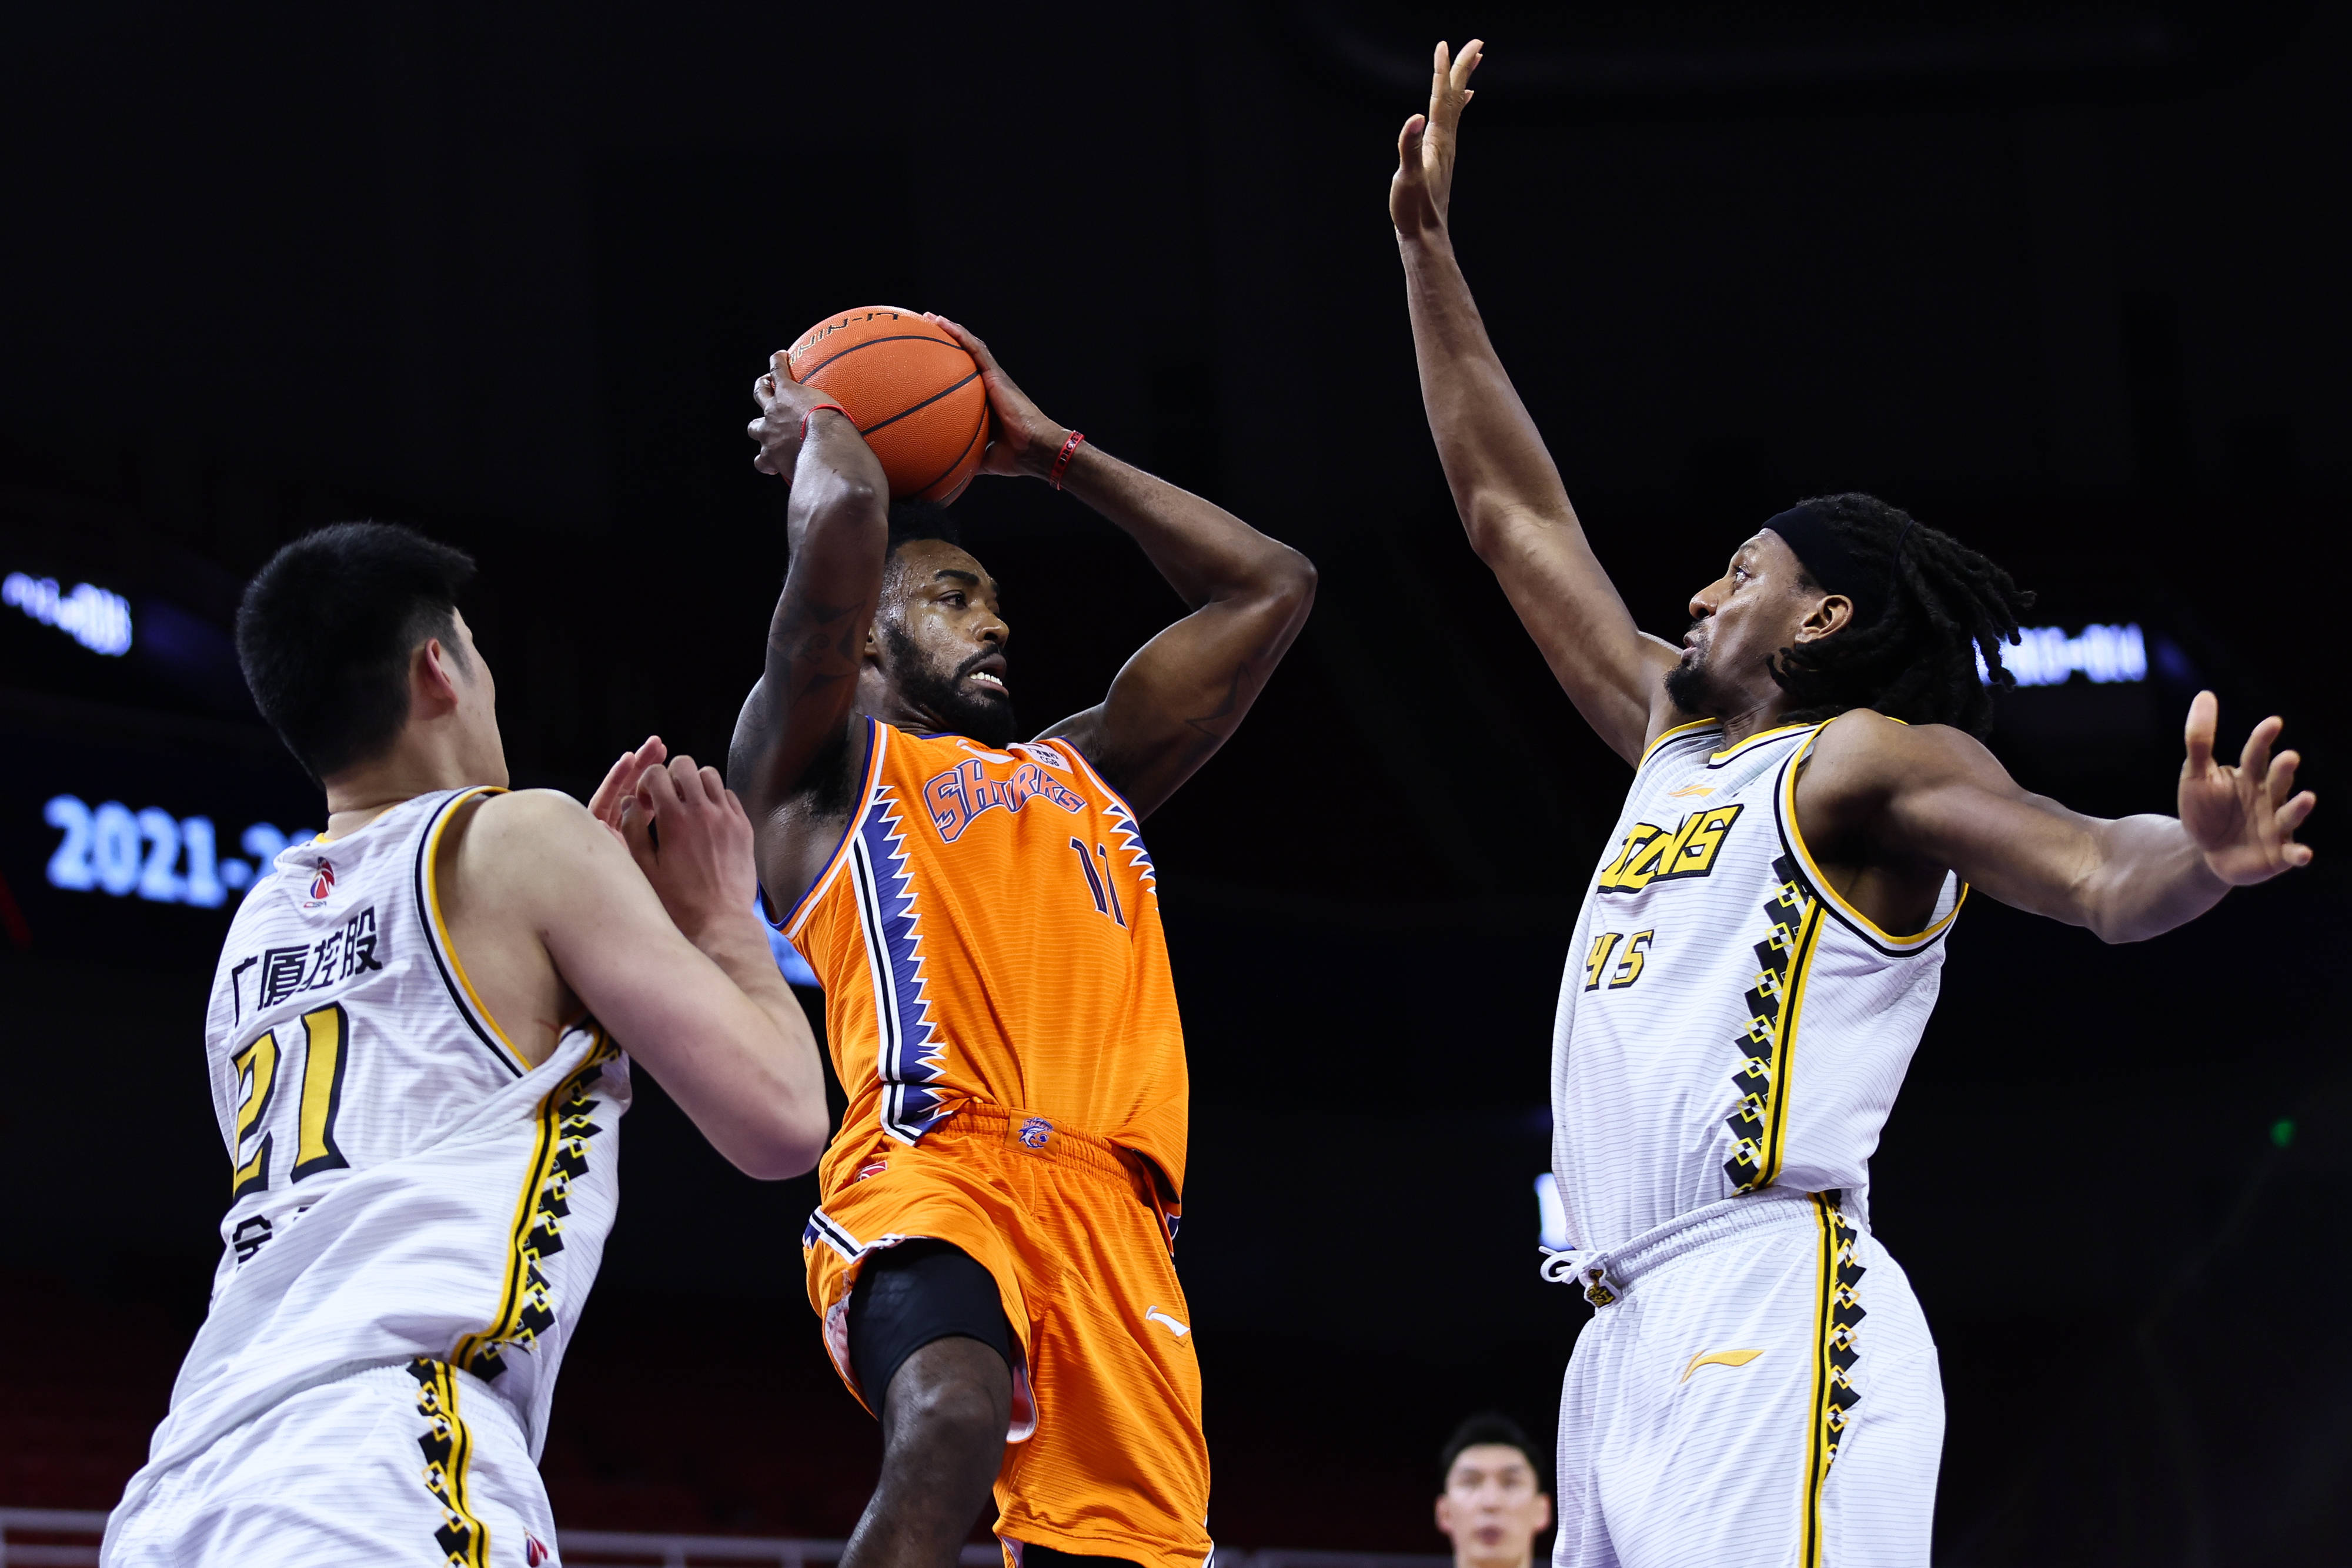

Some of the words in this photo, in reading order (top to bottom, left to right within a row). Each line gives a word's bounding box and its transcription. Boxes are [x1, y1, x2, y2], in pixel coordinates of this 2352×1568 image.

[1040, 756, 1060, 767] CGB
[44, 794, 322, 909] 2021-2
[1069, 835, 1129, 931] 11
[232, 905, 383, 1029] 广厦控股
[1585, 929, 1654, 993] 45
[231, 1001, 350, 1201] 21
